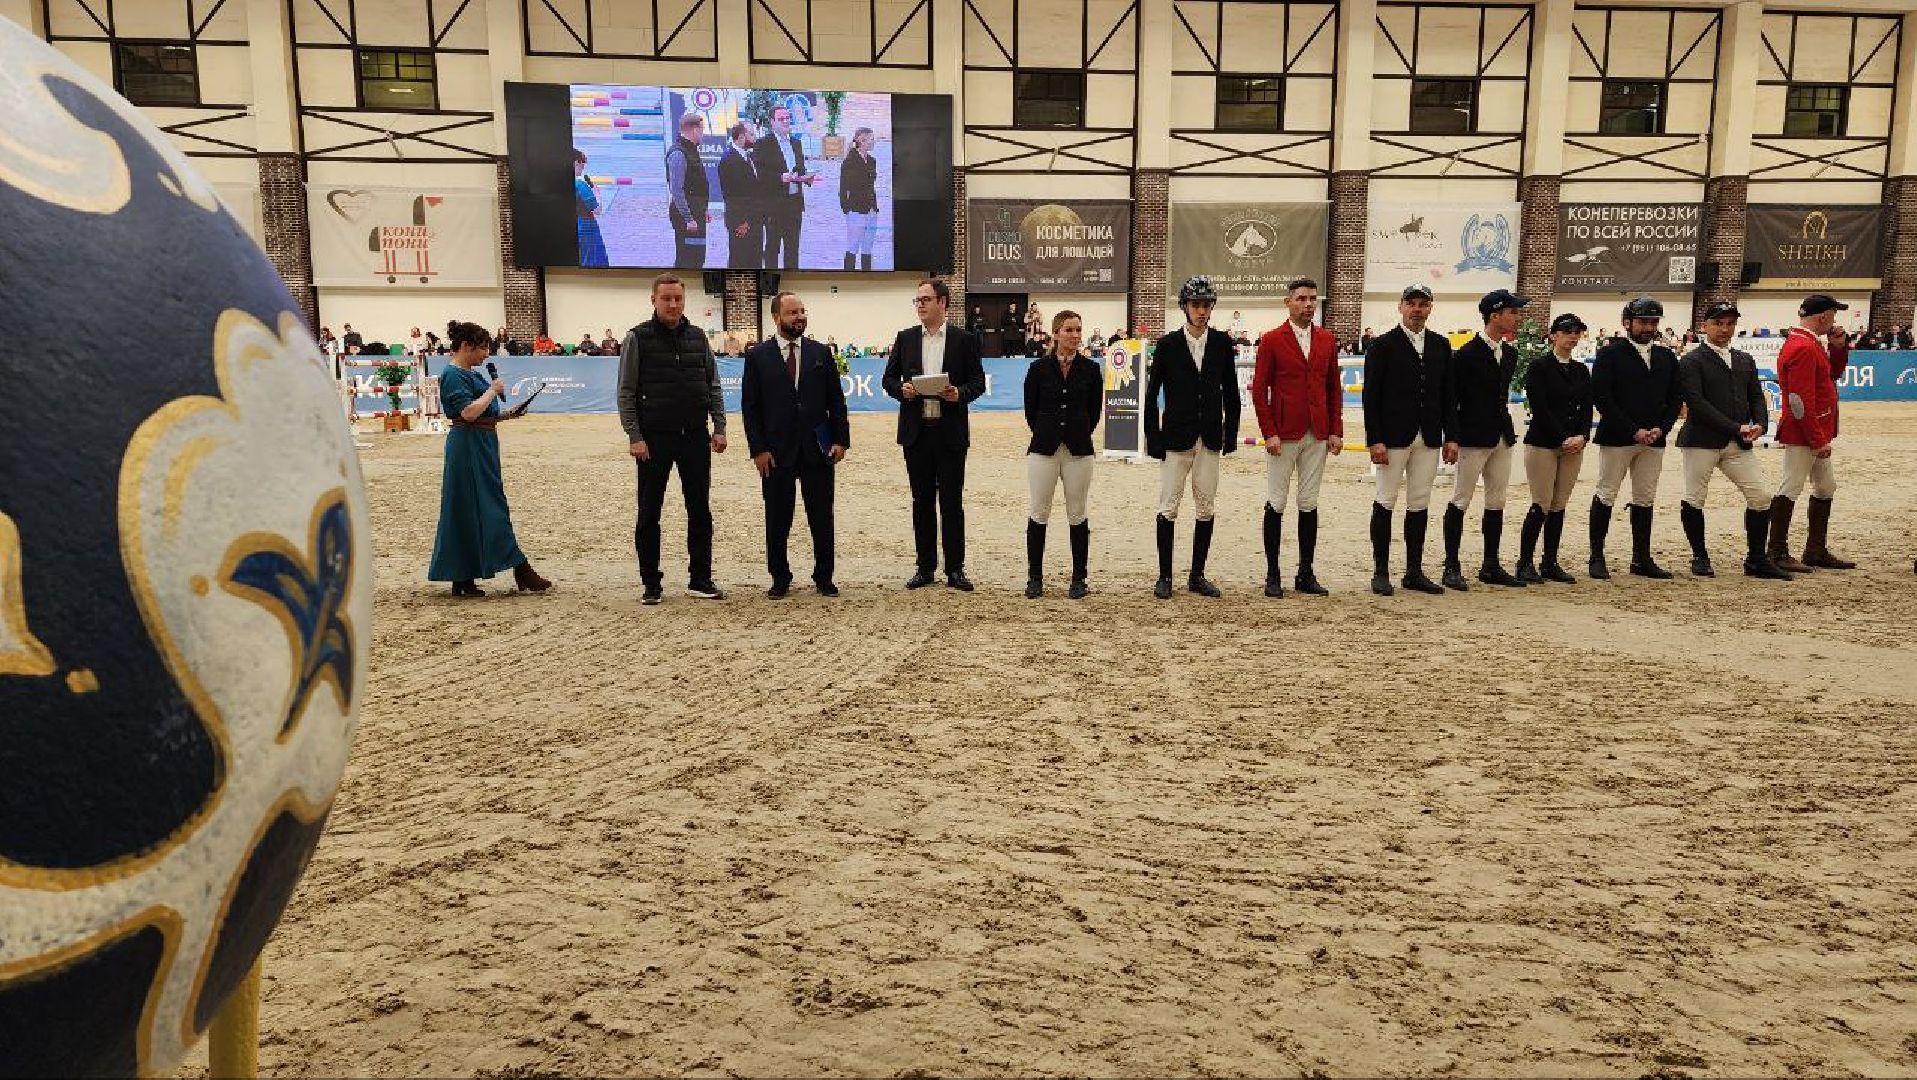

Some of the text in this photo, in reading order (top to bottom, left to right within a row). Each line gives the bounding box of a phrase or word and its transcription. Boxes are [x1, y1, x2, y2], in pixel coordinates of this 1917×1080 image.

[1567, 205, 1699, 221] КОНЕПЕРЕВОЗКИ
[1036, 225, 1114, 240] КОСМЕТИКА
[1567, 223, 1698, 239] ПО ВСЕЙ РОССИИ
[988, 243, 1022, 260] DEUS
[1036, 244, 1114, 260] ДЛЯ ЛОШАДЕЙ
[1778, 244, 1847, 260] SHEIKH
[1837, 365, 1874, 387] ЛЯ
[1105, 398, 1139, 406] MAXIMA
